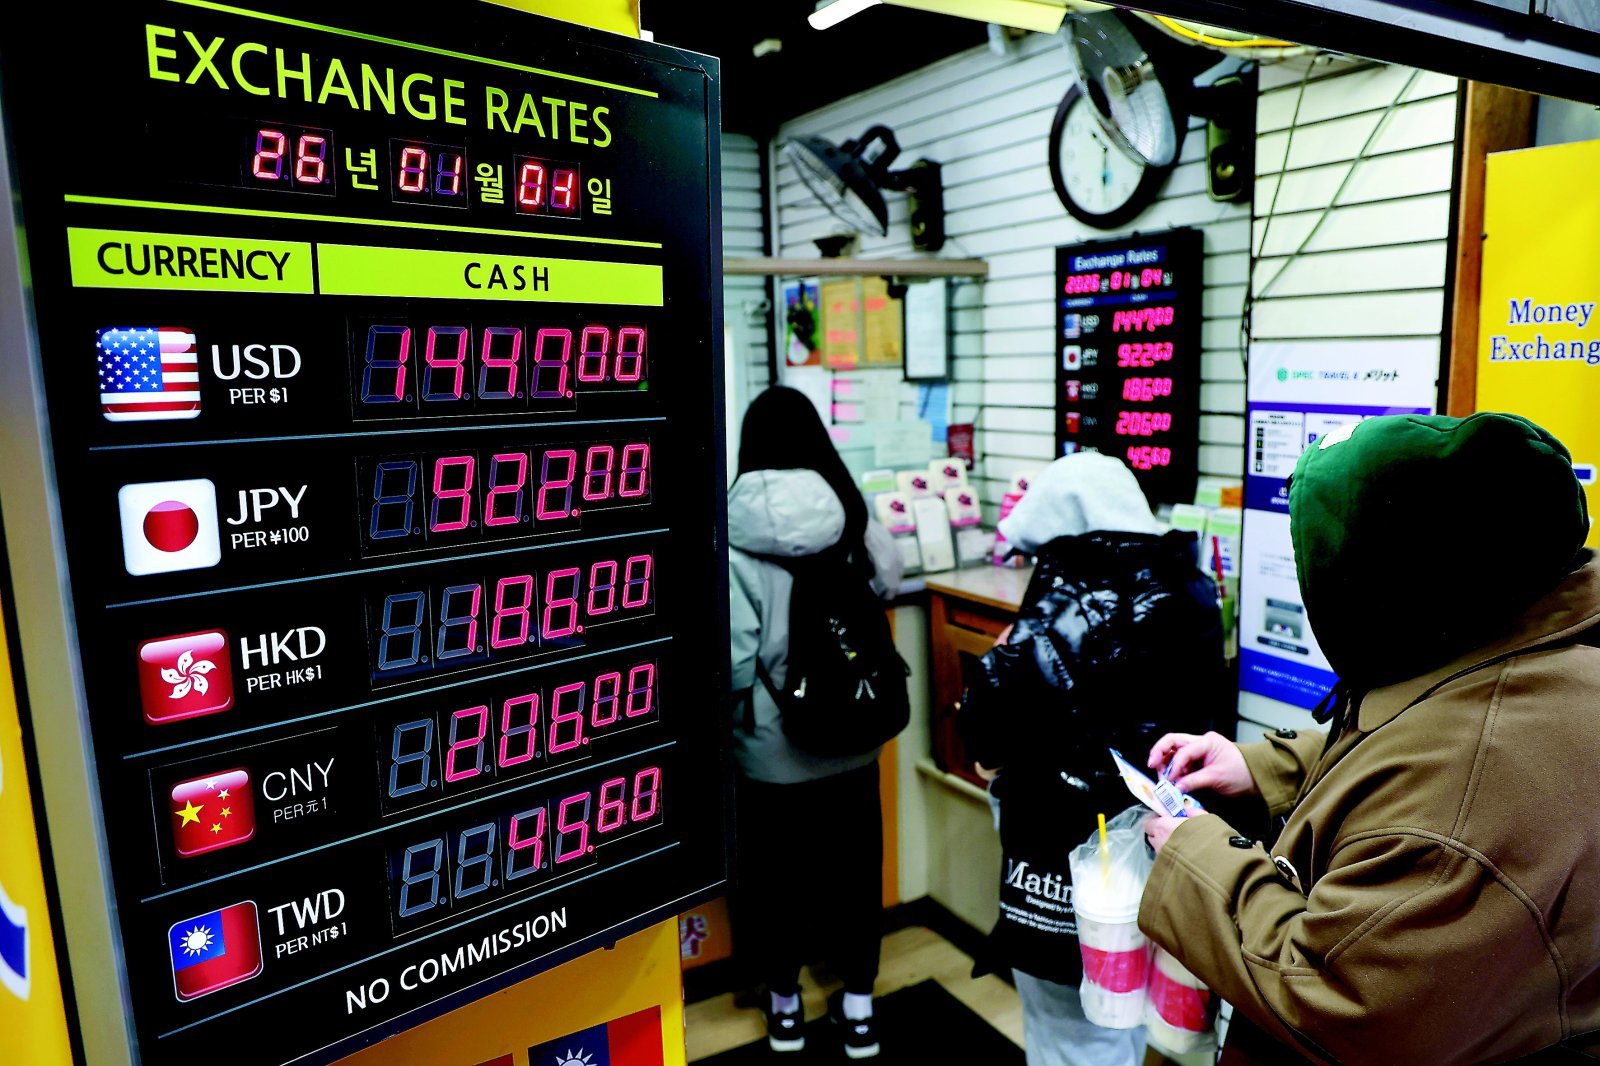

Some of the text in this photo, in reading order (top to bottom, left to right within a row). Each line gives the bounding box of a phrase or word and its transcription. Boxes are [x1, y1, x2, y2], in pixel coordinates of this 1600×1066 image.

[146, 23, 613, 148] EXCHANGE RATES
[252, 130, 326, 184] 26
[345, 147, 379, 191] 년
[399, 147, 461, 195] 01
[474, 162, 505, 204] 월
[587, 177, 612, 215] 일
[97, 241, 291, 281] CURRENCY
[463, 261, 550, 292] CASH
[1074, 254, 1125, 271] Exchange
[1509, 299, 1595, 328] Money
[211, 343, 302, 379] USD
[1490, 334, 1600, 366] Exchang
[229, 387, 288, 404] PER $1
[226, 485, 308, 525] JPY
[231, 526, 309, 549] PER ¥100
[240, 626, 326, 670] HKD
[246, 665, 322, 694] PER HK$1
[262, 757, 335, 801] CNY
[273, 803, 304, 824] PER
[267, 888, 346, 936] TWD
[275, 922, 347, 959] PER NT$1
[345, 907, 569, 1015] NO COMMISSION
